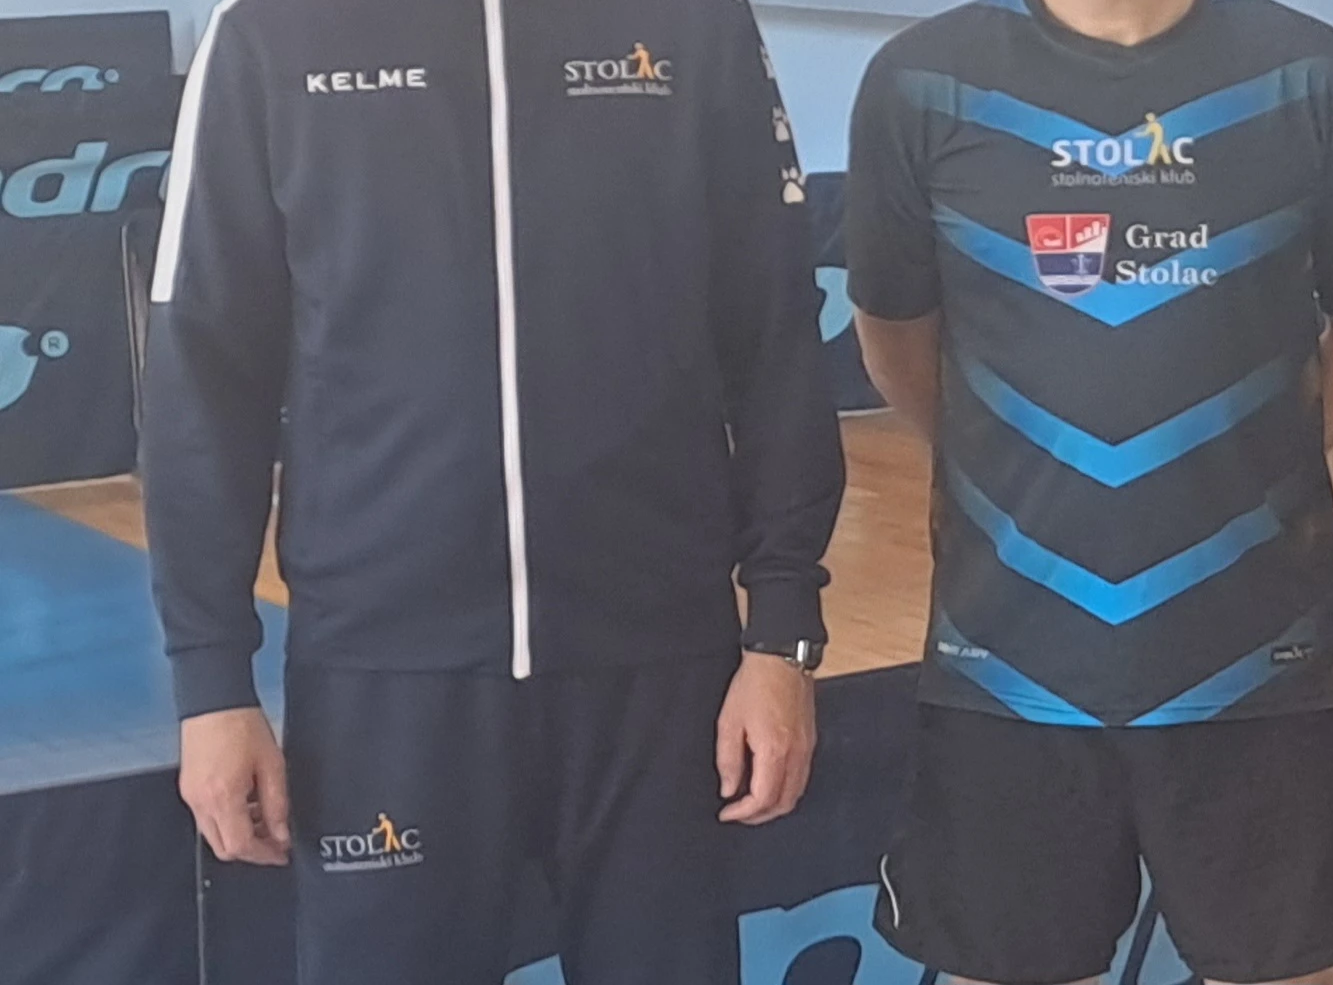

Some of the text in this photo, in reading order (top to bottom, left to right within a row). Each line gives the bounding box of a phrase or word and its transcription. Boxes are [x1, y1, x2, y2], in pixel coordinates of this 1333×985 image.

[306, 68, 428, 94] KELME
[1050, 112, 1195, 167] STOLAC
[1160, 169, 1196, 185] klub
[1125, 223, 1208, 249] Grad
[1115, 259, 1218, 286] Stolac
